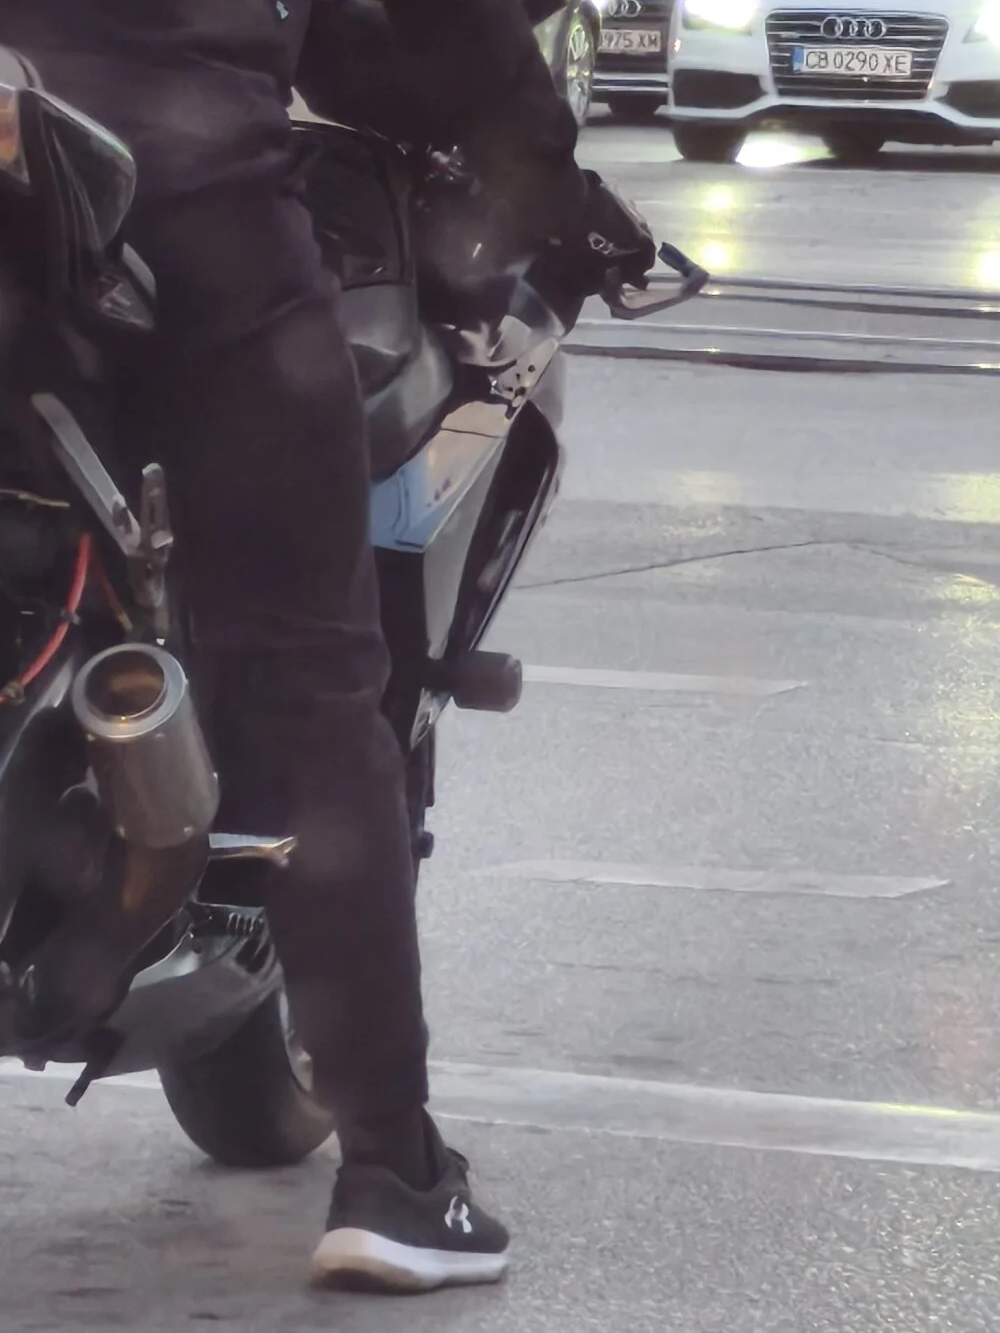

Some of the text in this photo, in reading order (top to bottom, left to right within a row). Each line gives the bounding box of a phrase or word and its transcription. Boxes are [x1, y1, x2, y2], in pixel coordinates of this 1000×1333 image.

[599, 32, 634, 49] 975
[834, 51, 879, 72] 0290
[883, 54, 908, 74] XE
